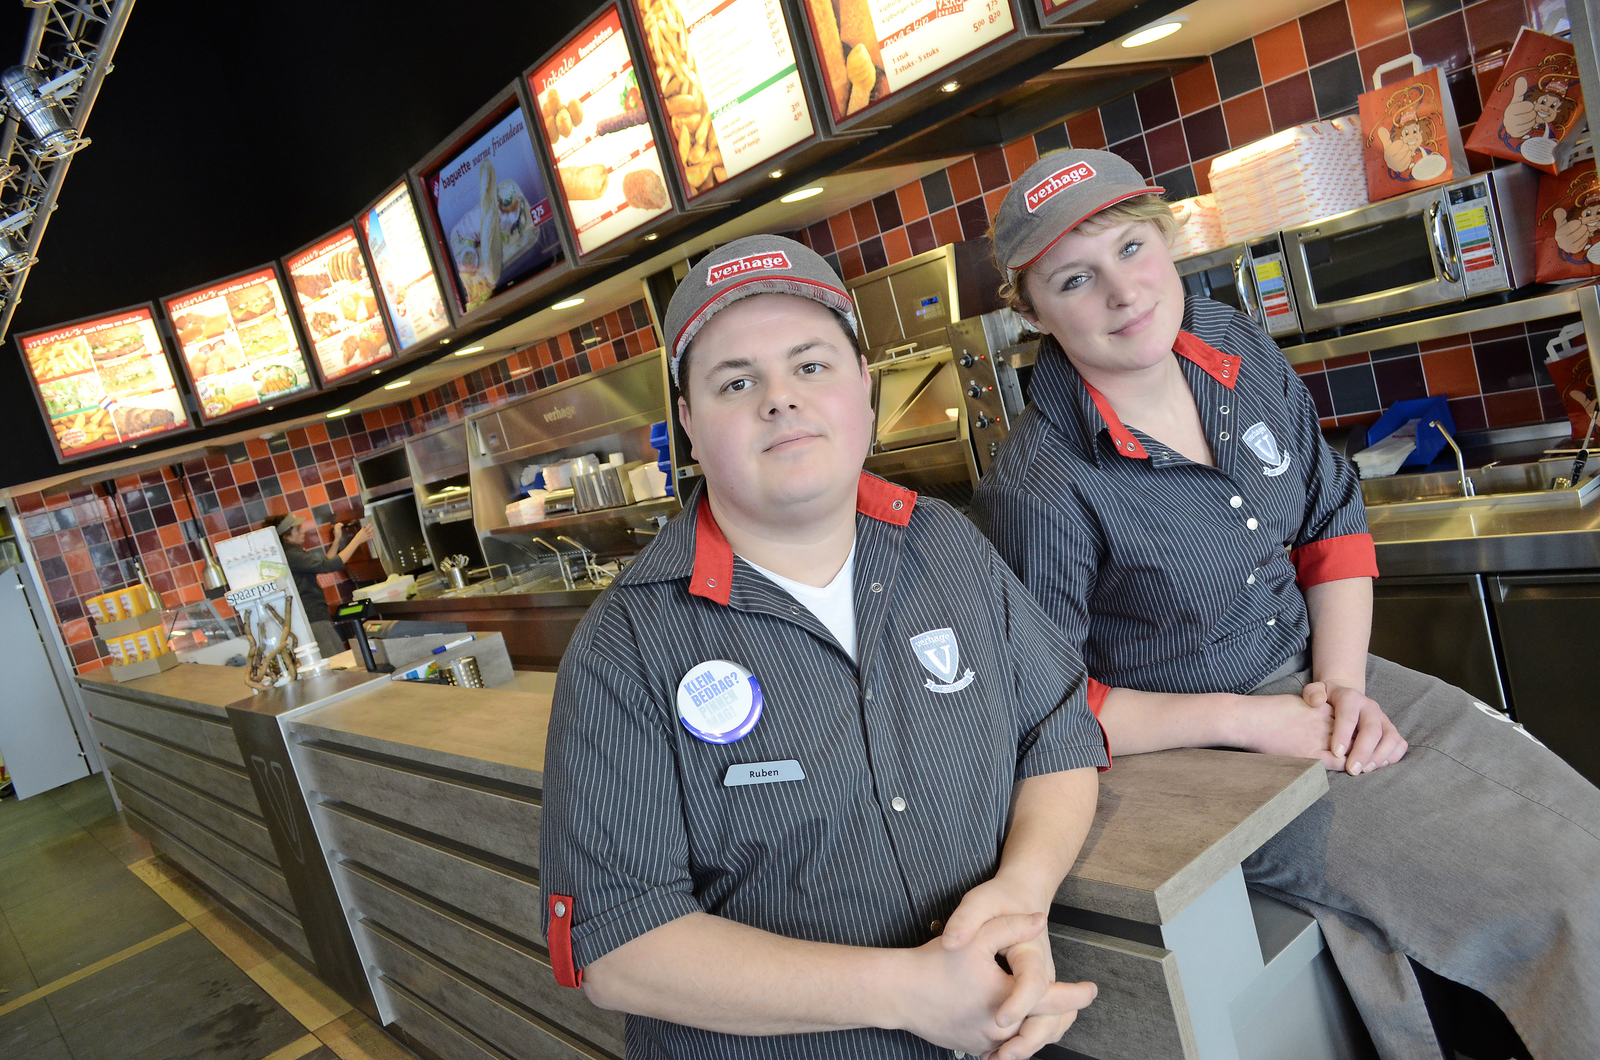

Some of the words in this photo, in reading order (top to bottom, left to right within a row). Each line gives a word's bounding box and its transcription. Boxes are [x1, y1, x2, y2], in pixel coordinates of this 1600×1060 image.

[896, 51, 909, 62] stuk
[899, 62, 915, 74] stuks
[923, 47, 940, 60] stuks
[542, 56, 576, 91] lokale
[441, 160, 471, 190] baguette
[471, 146, 491, 167] warme
[491, 121, 524, 157] fricandeau
[1029, 166, 1089, 204] verhage
[712, 255, 783, 279] verhage
[915, 633, 950, 647] verhage
[924, 644, 950, 674] V
[683, 670, 715, 696] KLEIN
[691, 671, 740, 708] BEDRAG?
[700, 688, 739, 719] PINNEN
[749, 768, 779, 779] Ruben
